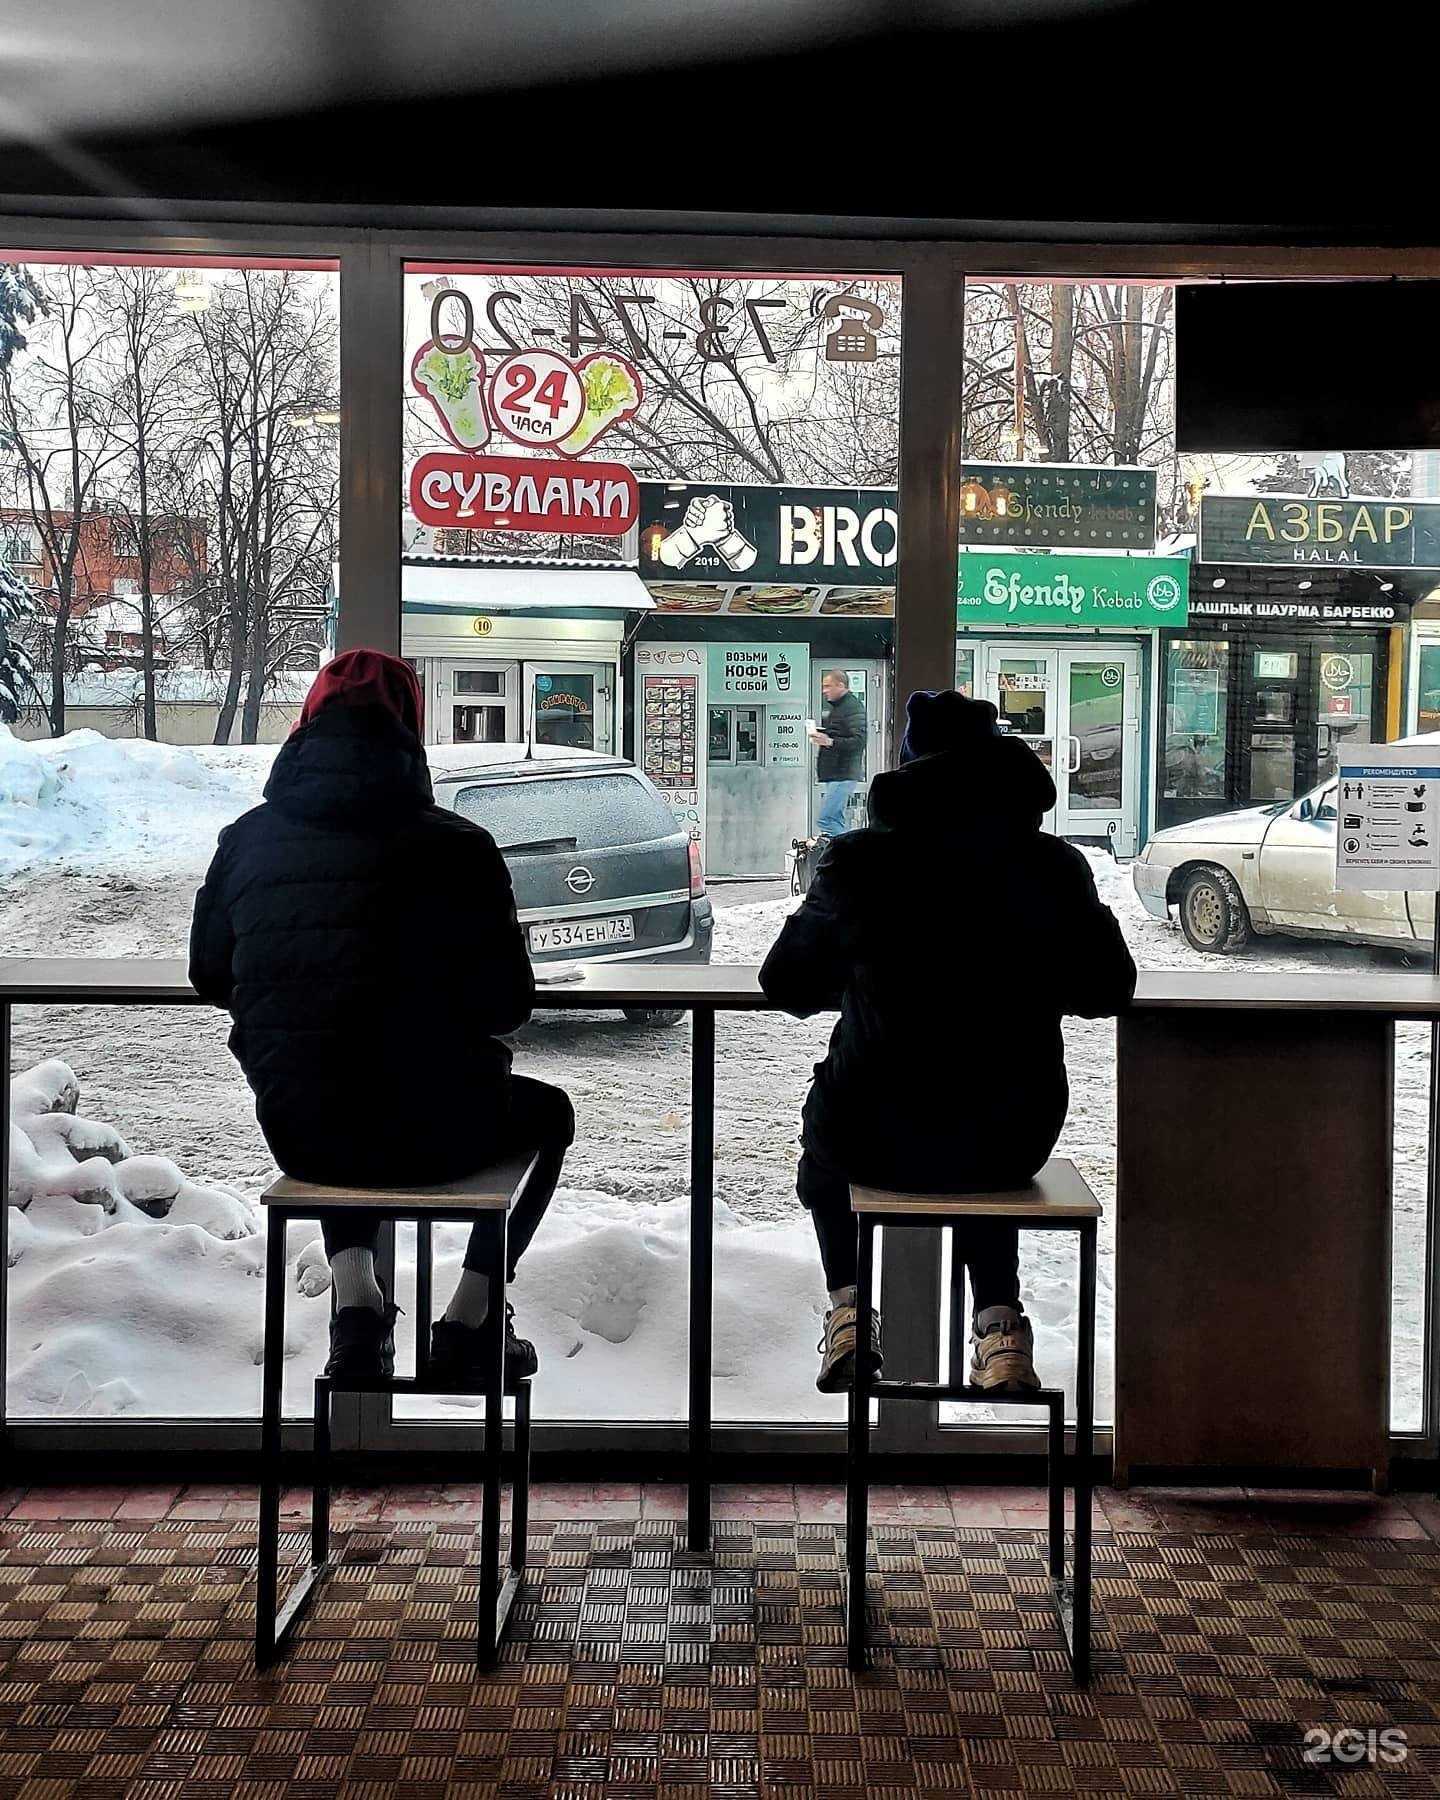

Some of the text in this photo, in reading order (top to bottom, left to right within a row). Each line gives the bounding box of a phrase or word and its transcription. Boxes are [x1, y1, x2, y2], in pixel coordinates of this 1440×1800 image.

[500, 364, 569, 420] 24
[511, 413, 552, 436] ЧАСА
[421, 470, 630, 519] СУВЛАКИ
[1006, 491, 1082, 524] Efendy
[1245, 501, 1411, 544] АЗБАР
[779, 505, 898, 567] BRO
[694, 557, 720, 567] 2019
[1293, 549, 1363, 563] HALAL
[983, 568, 1143, 615] Efendy Kebab
[1256, 603, 1320, 618] ШАУРМА
[1323, 605, 1395, 619] БАРБЕКЮ
[477, 621, 490, 631] 10
[726, 652, 768, 662] ВОЗЬМИ
[725, 665, 768, 678] КОФЕ
[725, 680, 768, 691] С СОБОЙ
[609, 919, 626, 934] 73
